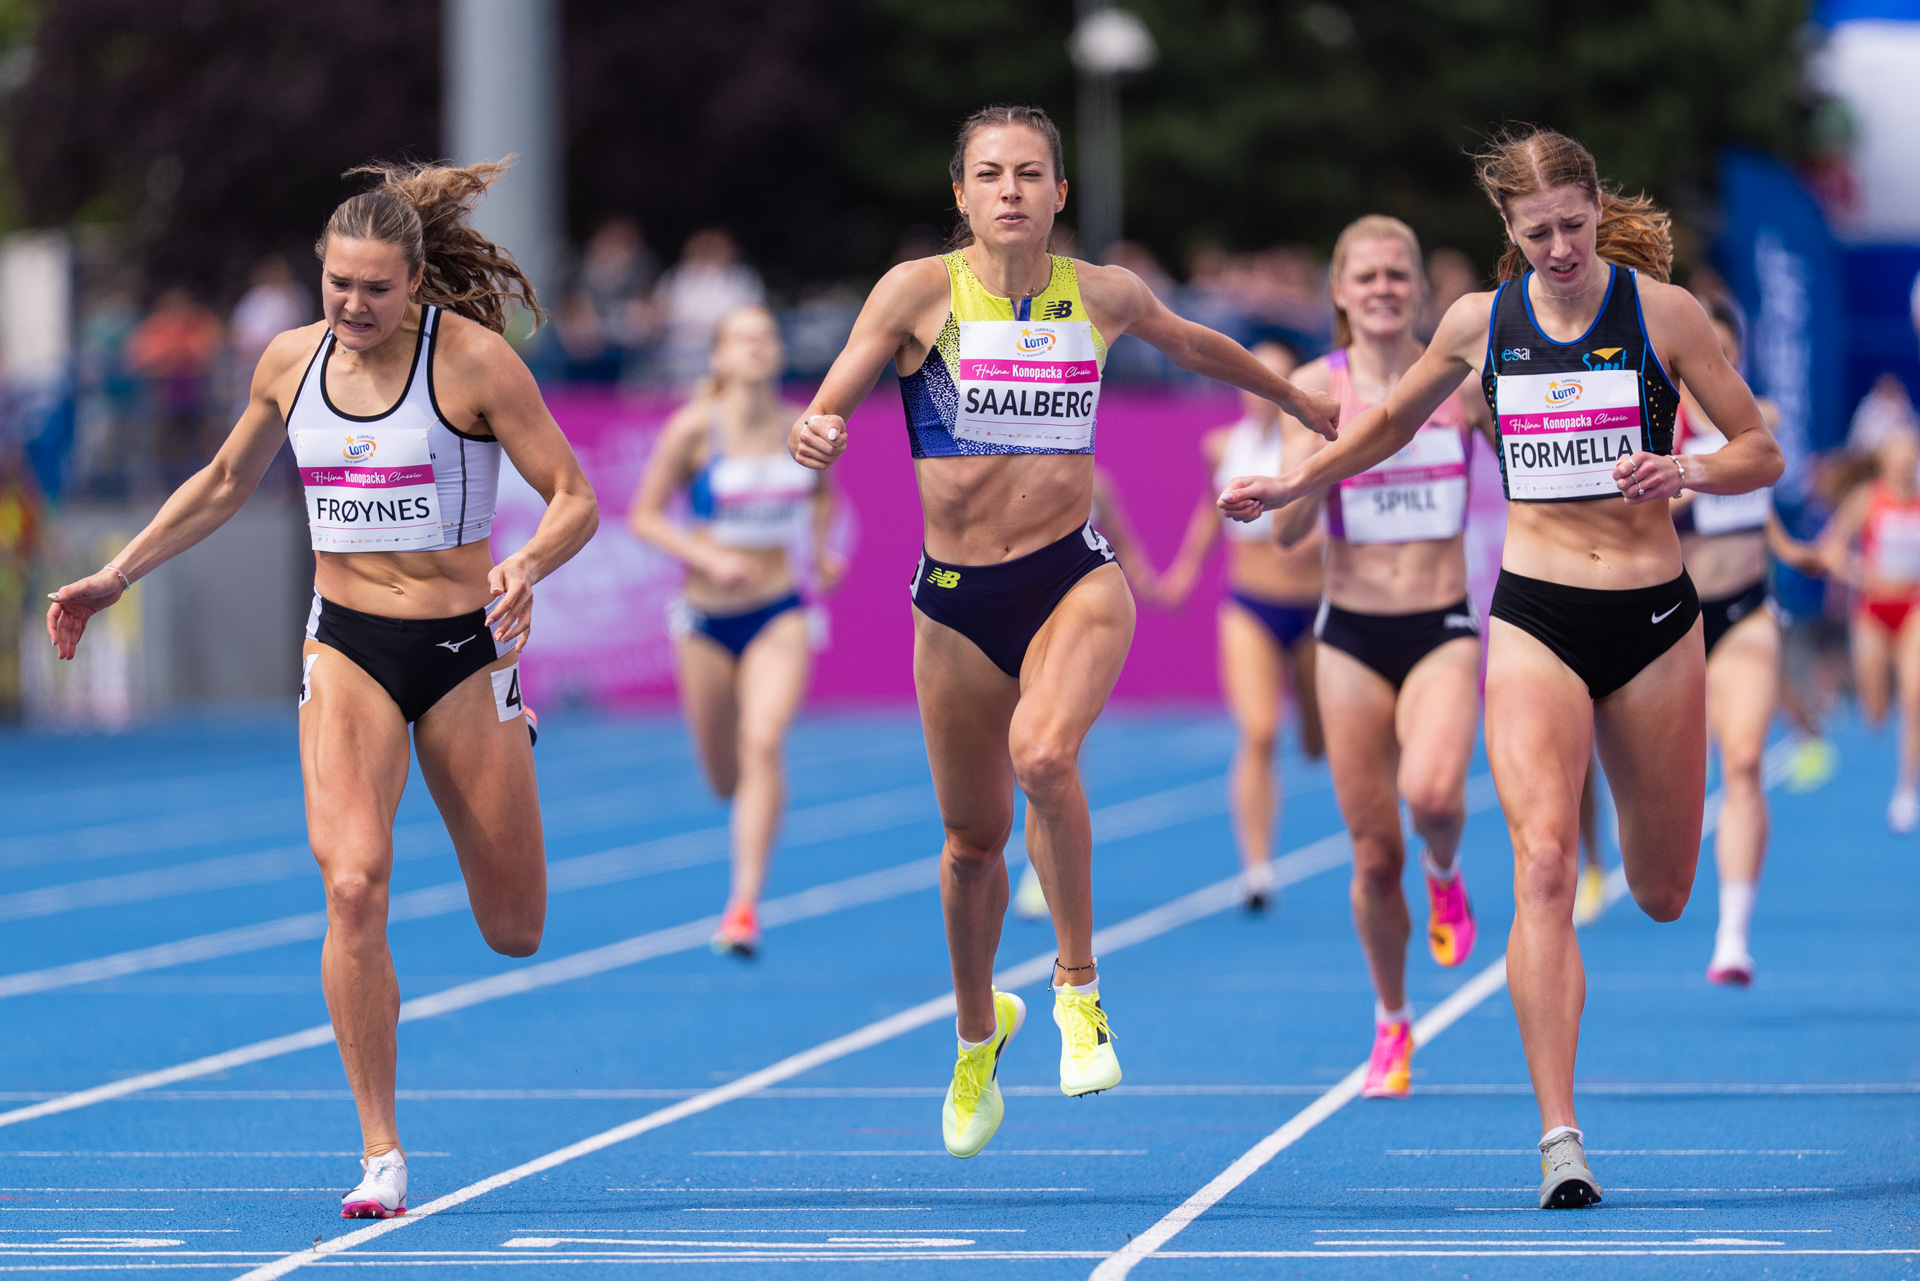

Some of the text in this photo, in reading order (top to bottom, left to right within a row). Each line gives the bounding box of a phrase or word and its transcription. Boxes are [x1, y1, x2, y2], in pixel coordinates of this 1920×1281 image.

[1024, 336, 1049, 349] LOTTO
[972, 363, 1092, 381] Halina Konopacka Classic
[965, 387, 1094, 419] SAALBERG
[1552, 386, 1576, 400] LOTTO
[1509, 413, 1629, 435] Halina Konopacka Classic
[348, 443, 370, 456] LOTTO
[1510, 434, 1634, 469] FORMELLA
[310, 470, 423, 486] Halina Konopacka Classic
[316, 496, 430, 523] FRØYNES
[1371, 488, 1439, 515] SPILL
[505, 667, 522, 711] 4
